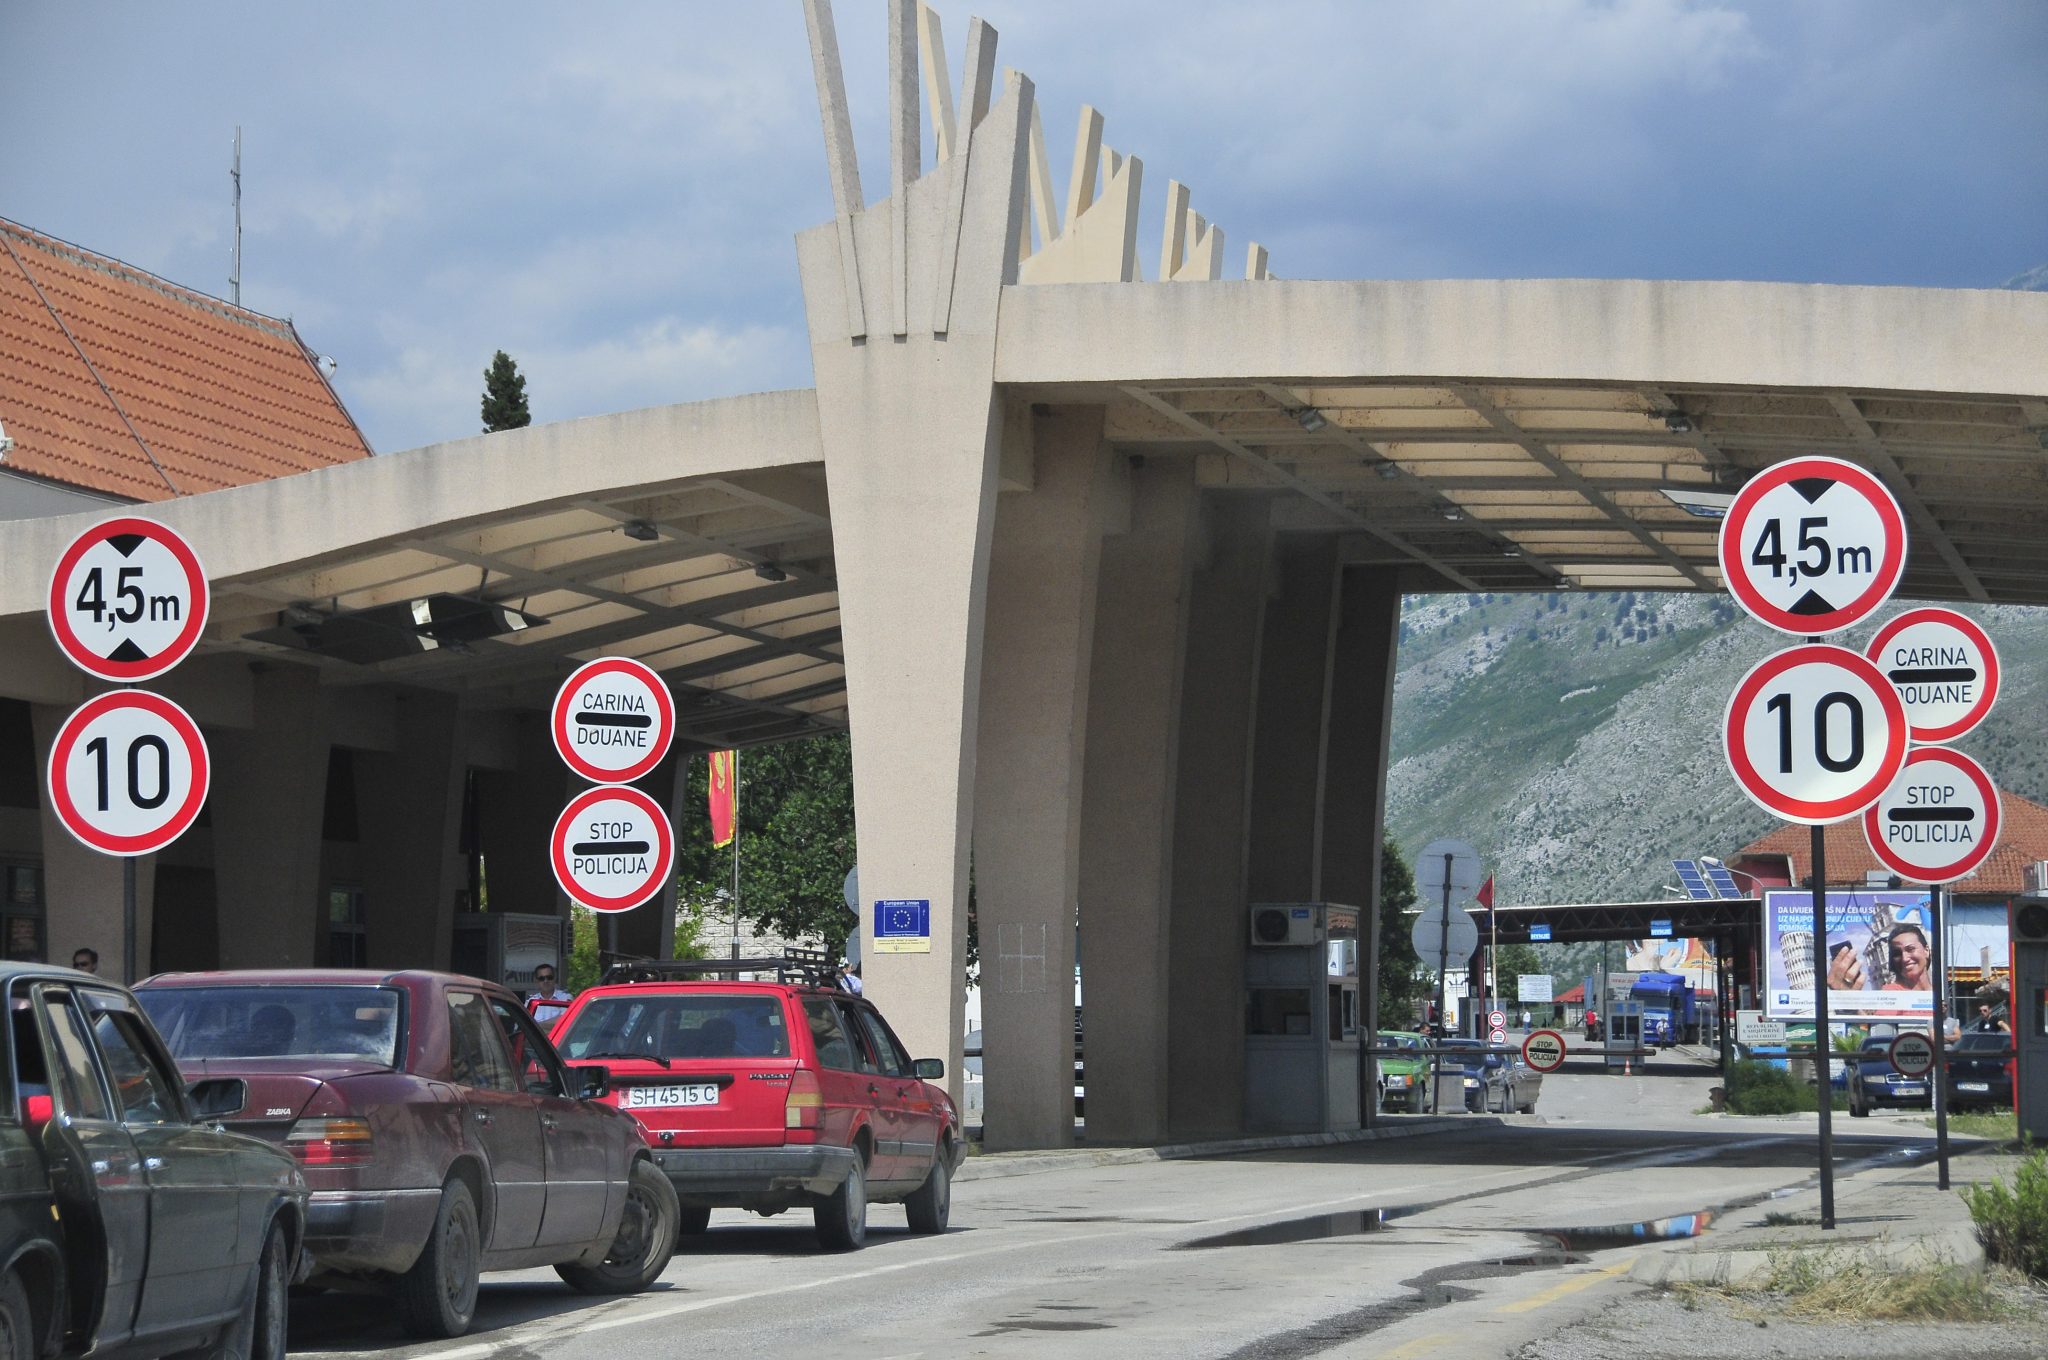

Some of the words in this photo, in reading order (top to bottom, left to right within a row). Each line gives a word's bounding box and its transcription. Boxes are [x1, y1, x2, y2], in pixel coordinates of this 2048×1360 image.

[1895, 647, 1968, 667] CARINA
[582, 692, 647, 713] CARINA
[577, 727, 647, 748] DOUANE
[1766, 691, 1865, 774] 10
[86, 733, 171, 812] 10
[1906, 785, 1956, 806] STOP
[589, 822, 634, 840] STOP
[1888, 823, 1973, 844] POLICIJA
[572, 856, 649, 876] POLICIJA
[1536, 1040, 1553, 1048] STOP
[1903, 1043, 1921, 1051] STOP
[1529, 1052, 1557, 1062] POLICIJA
[632, 1088, 657, 1105] SH
[660, 1086, 699, 1104] 4515
[704, 1085, 716, 1102] C
